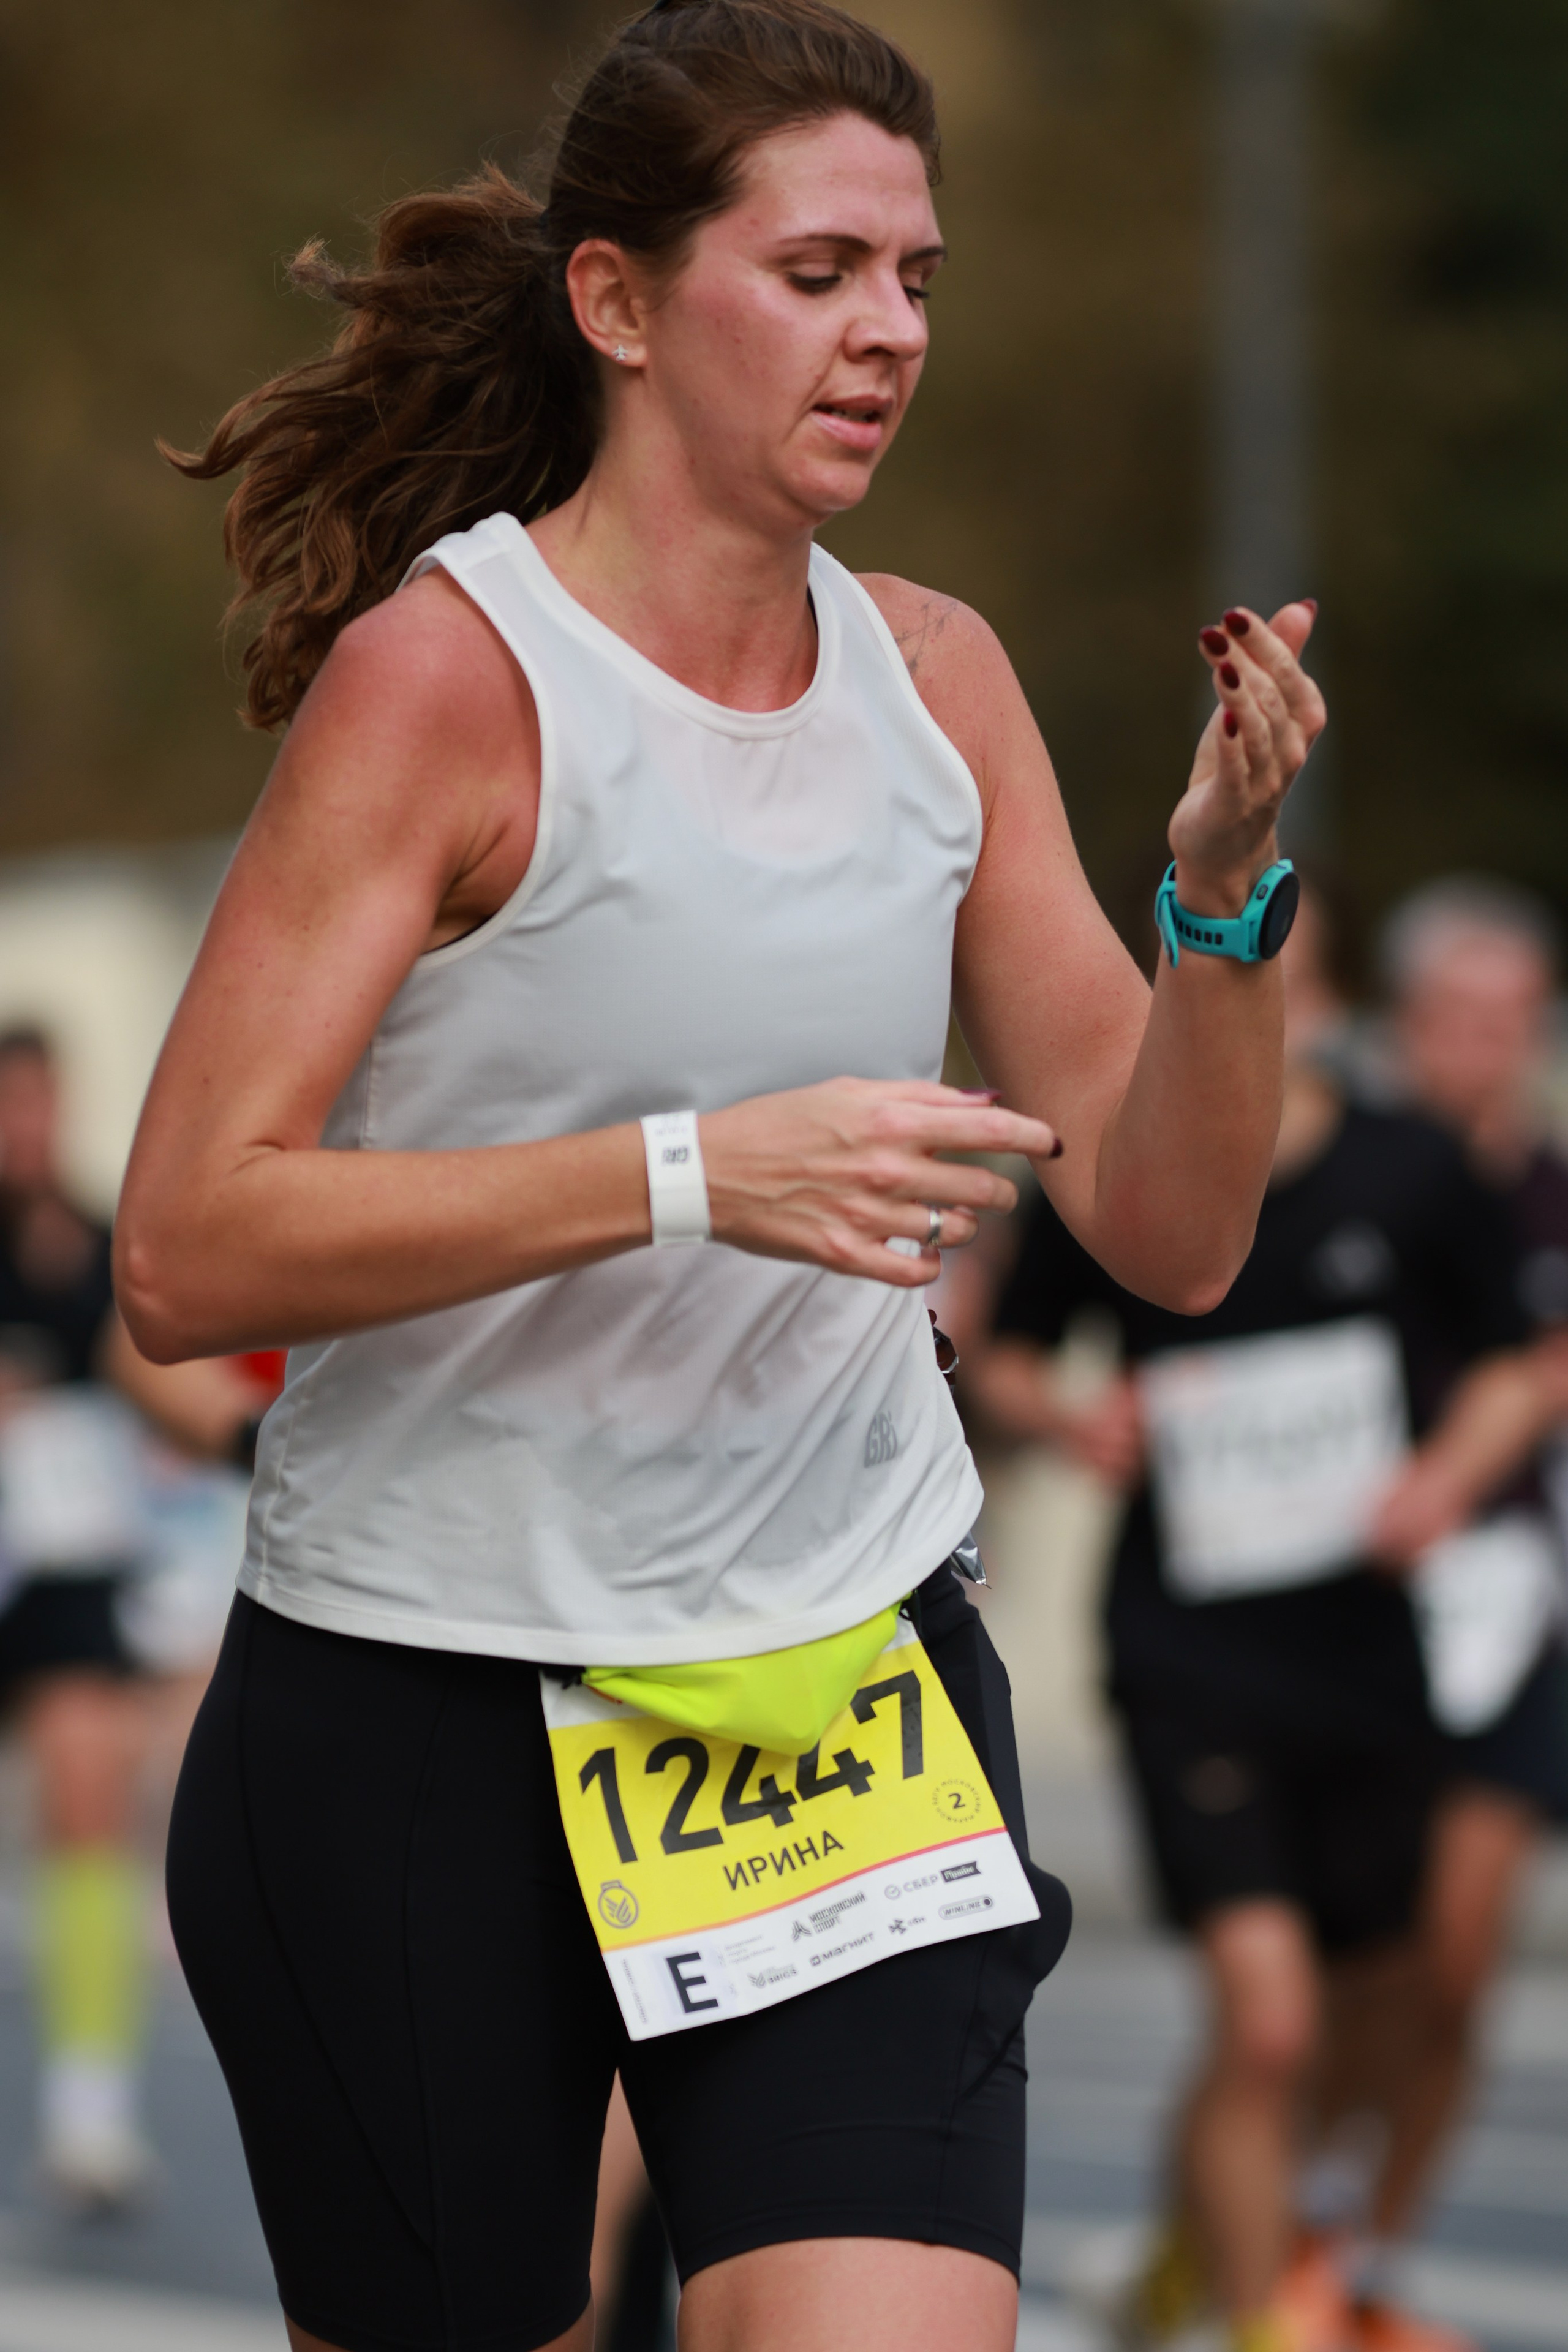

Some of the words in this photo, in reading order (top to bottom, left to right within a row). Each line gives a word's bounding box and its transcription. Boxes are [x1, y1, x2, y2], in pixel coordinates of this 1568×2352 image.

[579, 1670, 924, 1864] 12447
[948, 1792, 966, 1809] 2
[723, 1830, 845, 1891] ИРИНА
[666, 1951, 719, 2013] E
